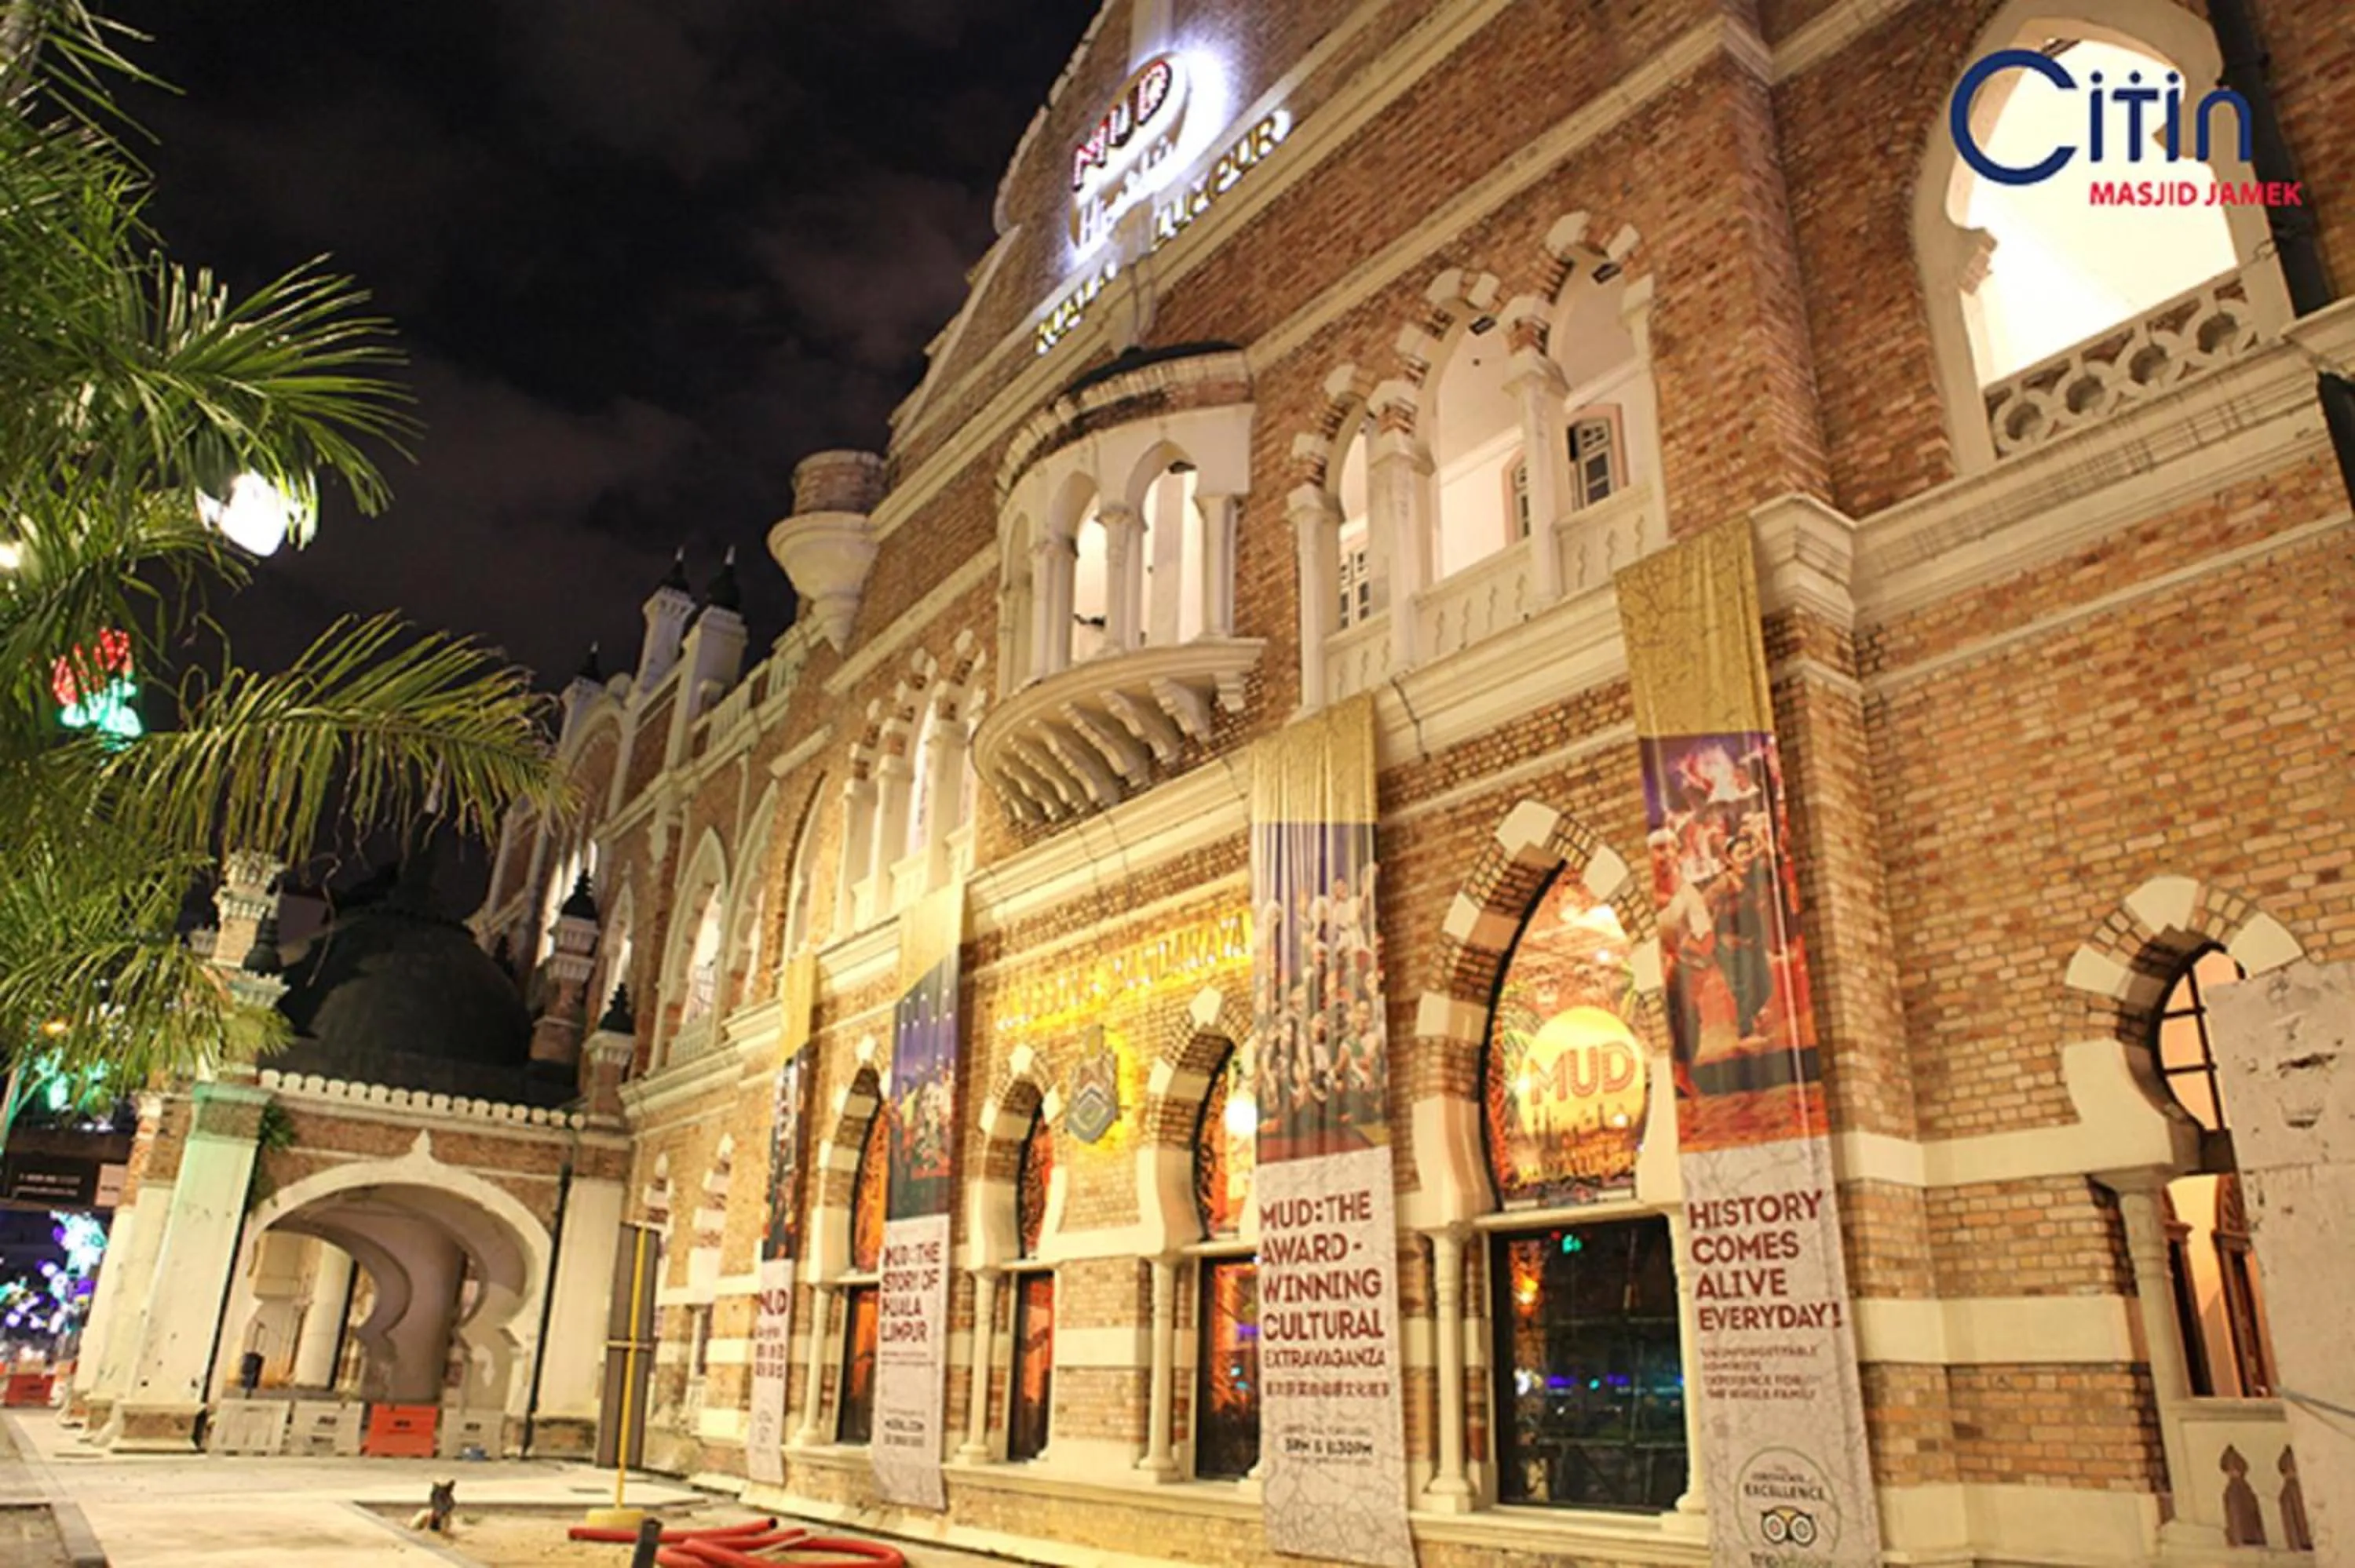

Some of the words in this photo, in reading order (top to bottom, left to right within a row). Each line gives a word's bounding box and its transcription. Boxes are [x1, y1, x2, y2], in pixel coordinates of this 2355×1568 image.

[1072, 60, 1173, 192] MUD
[1529, 1040, 1638, 1107] MUD
[1689, 1189, 1823, 1229] HISTORY
[1691, 1230, 1800, 1265] COMES
[1263, 1268, 1382, 1303] WINNING
[1696, 1268, 1788, 1300] ALIVE
[1263, 1308, 1386, 1341] CULTURAL
[1699, 1302, 1842, 1331] EVERYDAY!
[1265, 1347, 1386, 1369] EXTRAVAGANZA
